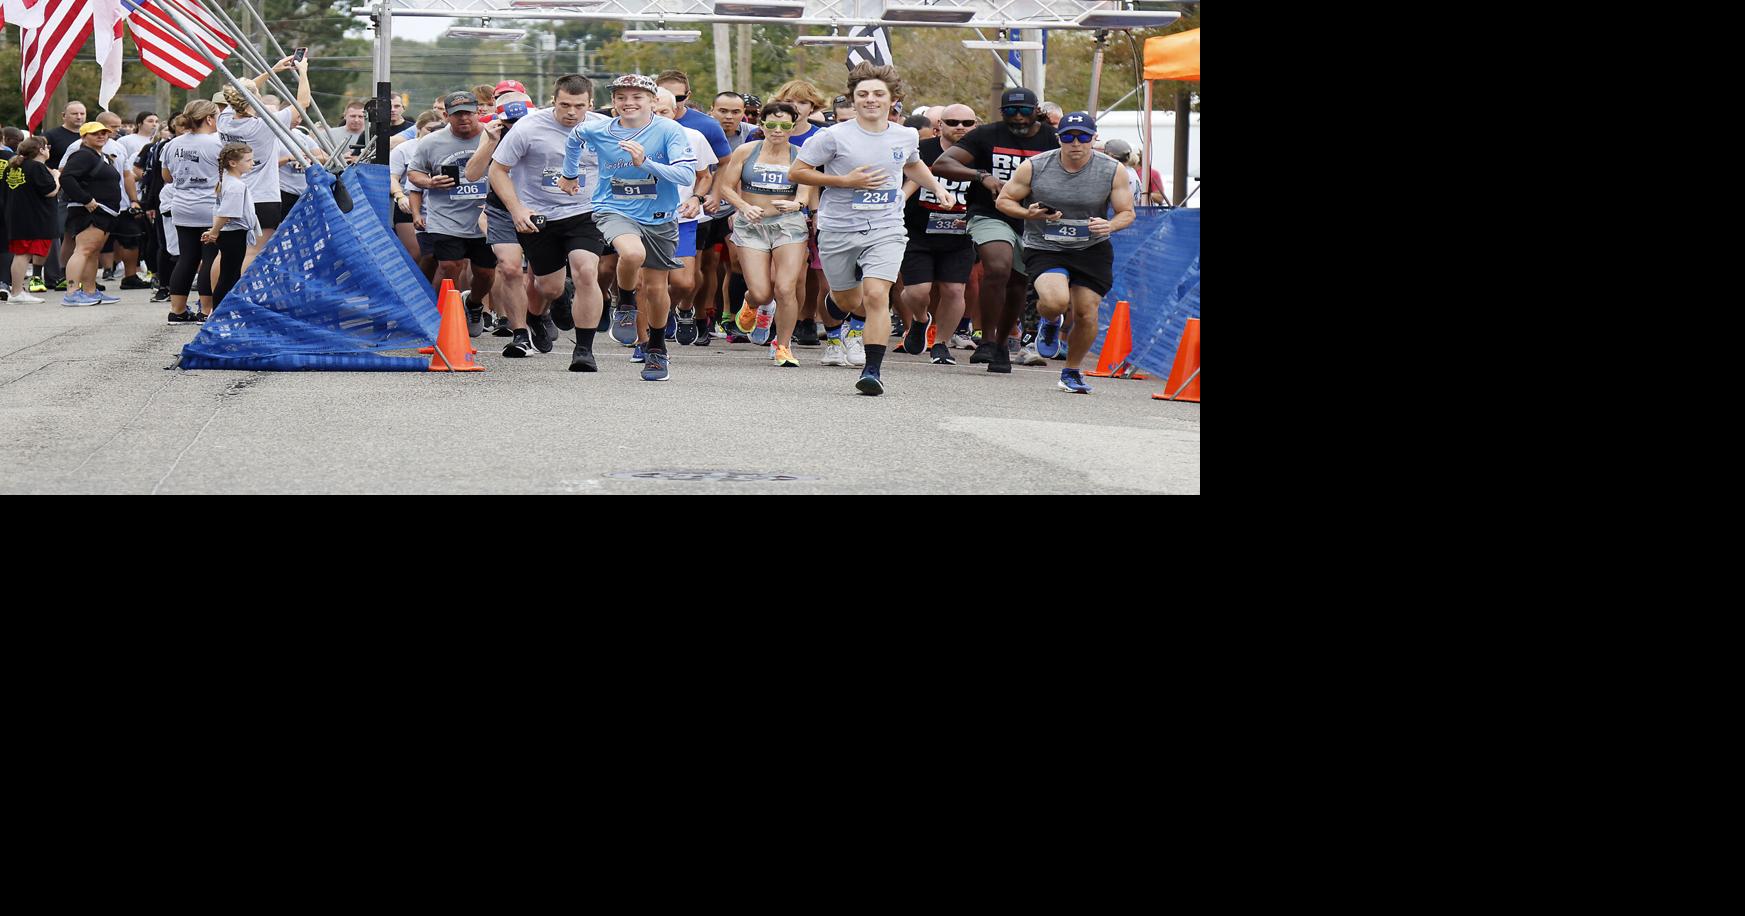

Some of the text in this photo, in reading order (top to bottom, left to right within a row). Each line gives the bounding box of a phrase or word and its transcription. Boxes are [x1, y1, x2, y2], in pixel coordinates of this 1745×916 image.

[761, 172, 783, 183] 191
[456, 184, 479, 194] 206
[624, 186, 641, 195] 91
[862, 192, 889, 203] 234
[1058, 226, 1077, 236] 43
